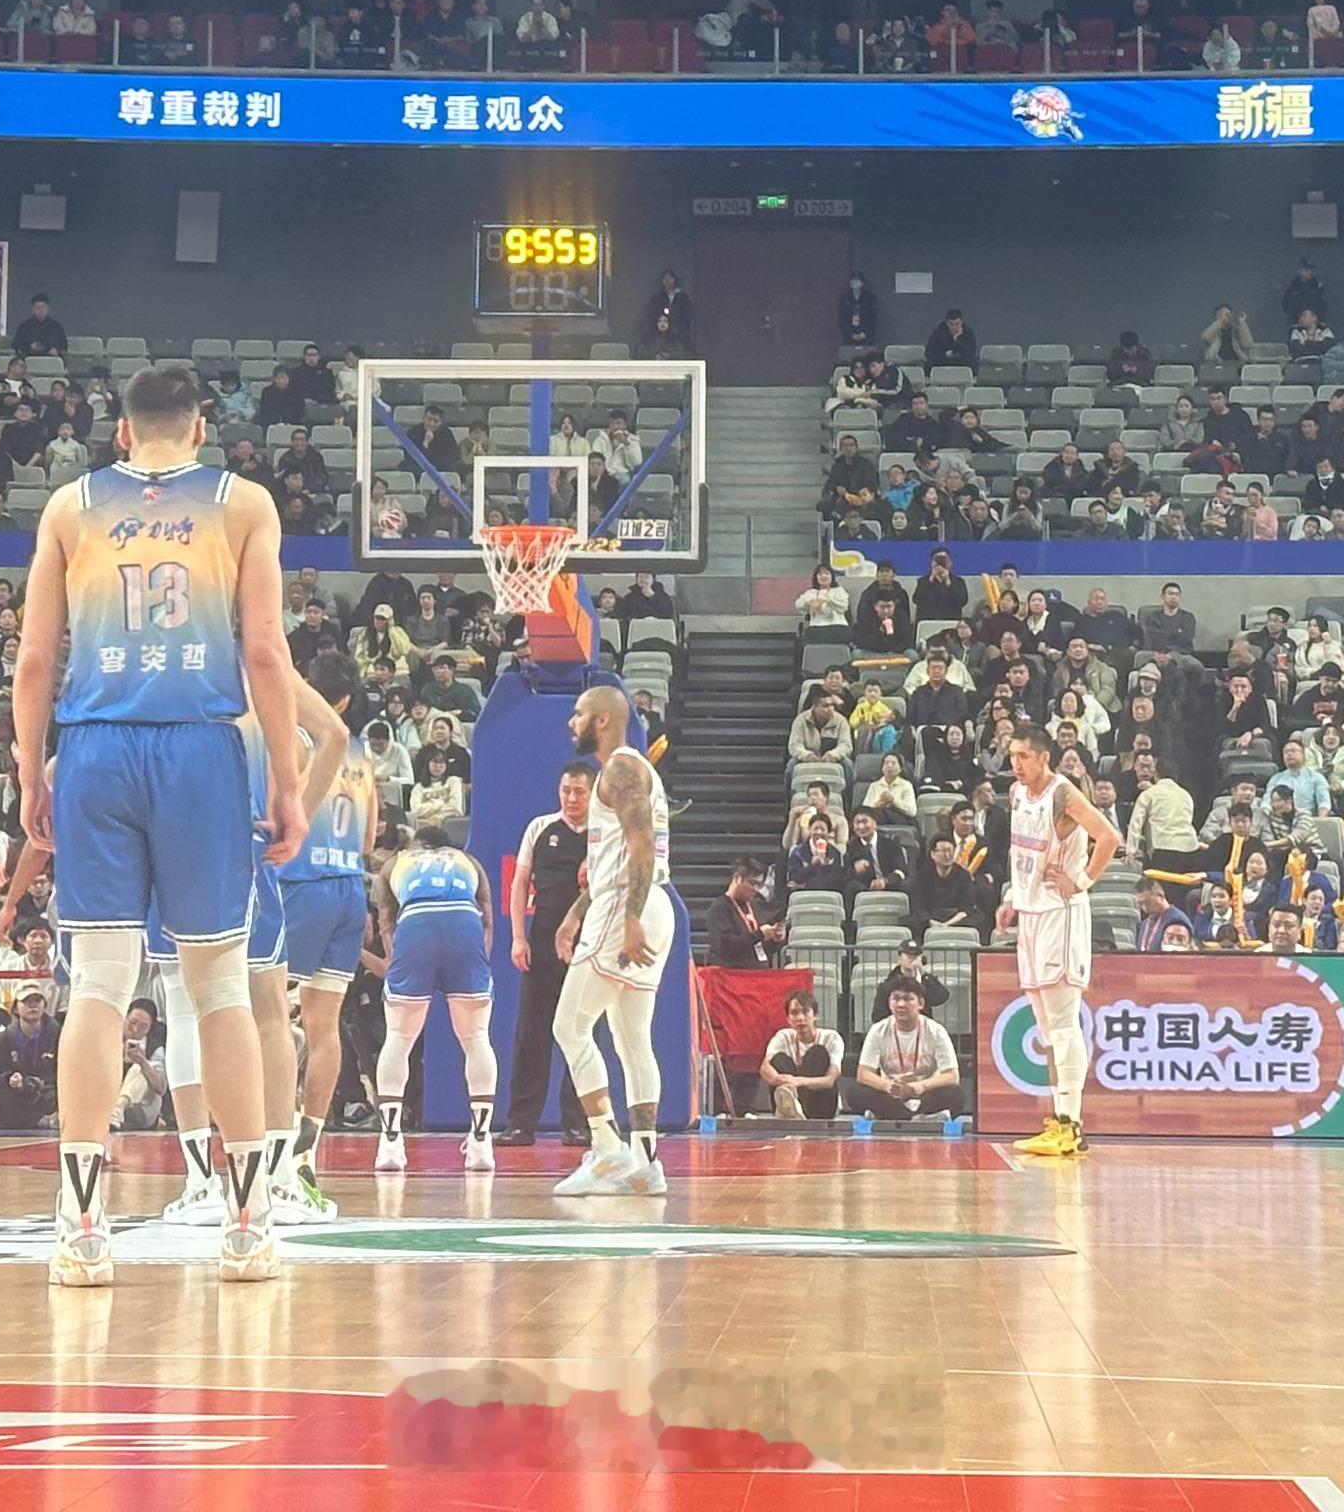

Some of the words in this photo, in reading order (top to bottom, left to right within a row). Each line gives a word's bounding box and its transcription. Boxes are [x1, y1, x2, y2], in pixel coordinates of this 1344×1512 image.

[118, 89, 281, 129] 尊重裁判
[402, 94, 565, 131] 尊重观众
[1215, 81, 1314, 139] 新疆
[118, 562, 191, 632] 13
[99, 643, 206, 673] 李炎哲
[333, 794, 353, 838] 0
[1103, 1008, 1314, 1054] 中国人寿
[1105, 1058, 1219, 1083] CHINA
[1233, 1060, 1311, 1083] LIFE
